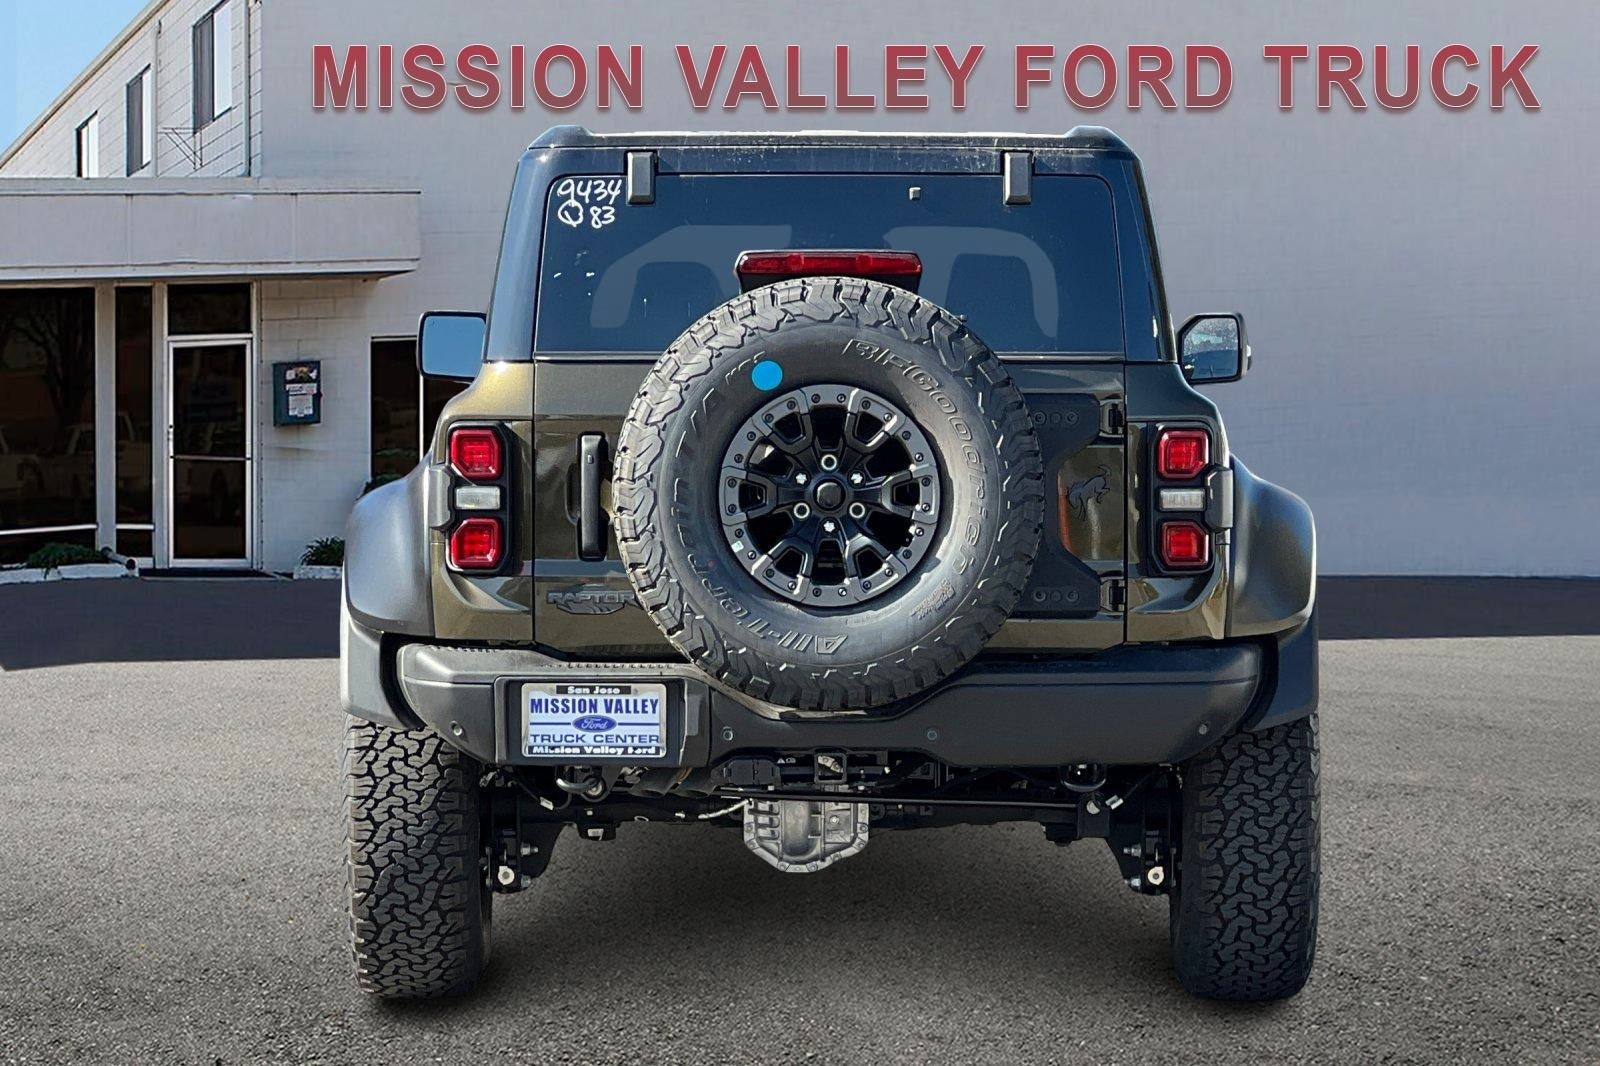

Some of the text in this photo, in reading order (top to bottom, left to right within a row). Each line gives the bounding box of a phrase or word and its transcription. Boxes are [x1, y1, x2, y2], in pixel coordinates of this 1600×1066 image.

[312, 43, 1541, 110] MISSION VALLEY FORD TRUCK
[556, 178, 623, 207] 9434
[589, 205, 616, 229] 83
[547, 590, 635, 604] RAPTOR
[567, 686, 621, 694] San Jose
[530, 698, 659, 714] MISSION VALLEY
[581, 718, 608, 730] Ford
[530, 734, 660, 743] TRUCK CENTER
[584, 746, 625, 756] Valley
